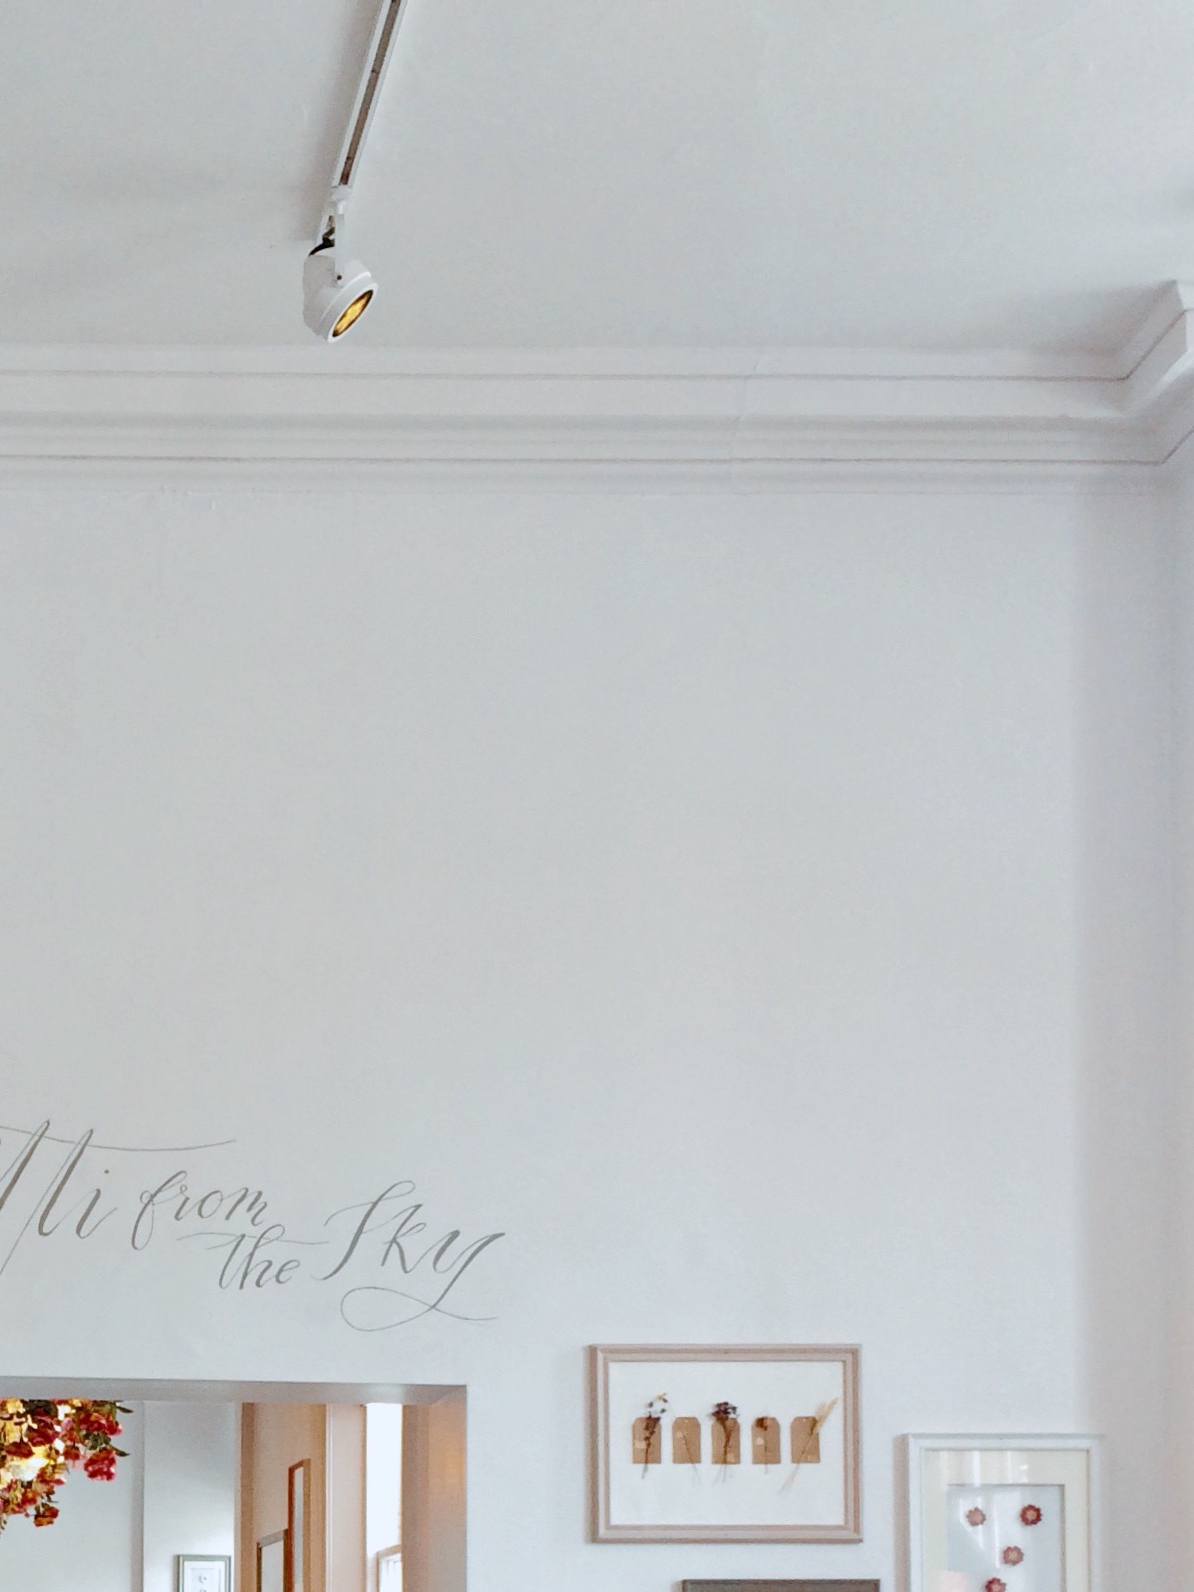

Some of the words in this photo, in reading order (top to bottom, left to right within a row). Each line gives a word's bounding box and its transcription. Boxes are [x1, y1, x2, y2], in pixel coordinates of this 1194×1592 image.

[132, 1170, 267, 1251] from
[177, 1224, 329, 1290] the
[310, 1180, 505, 1331] Sky
